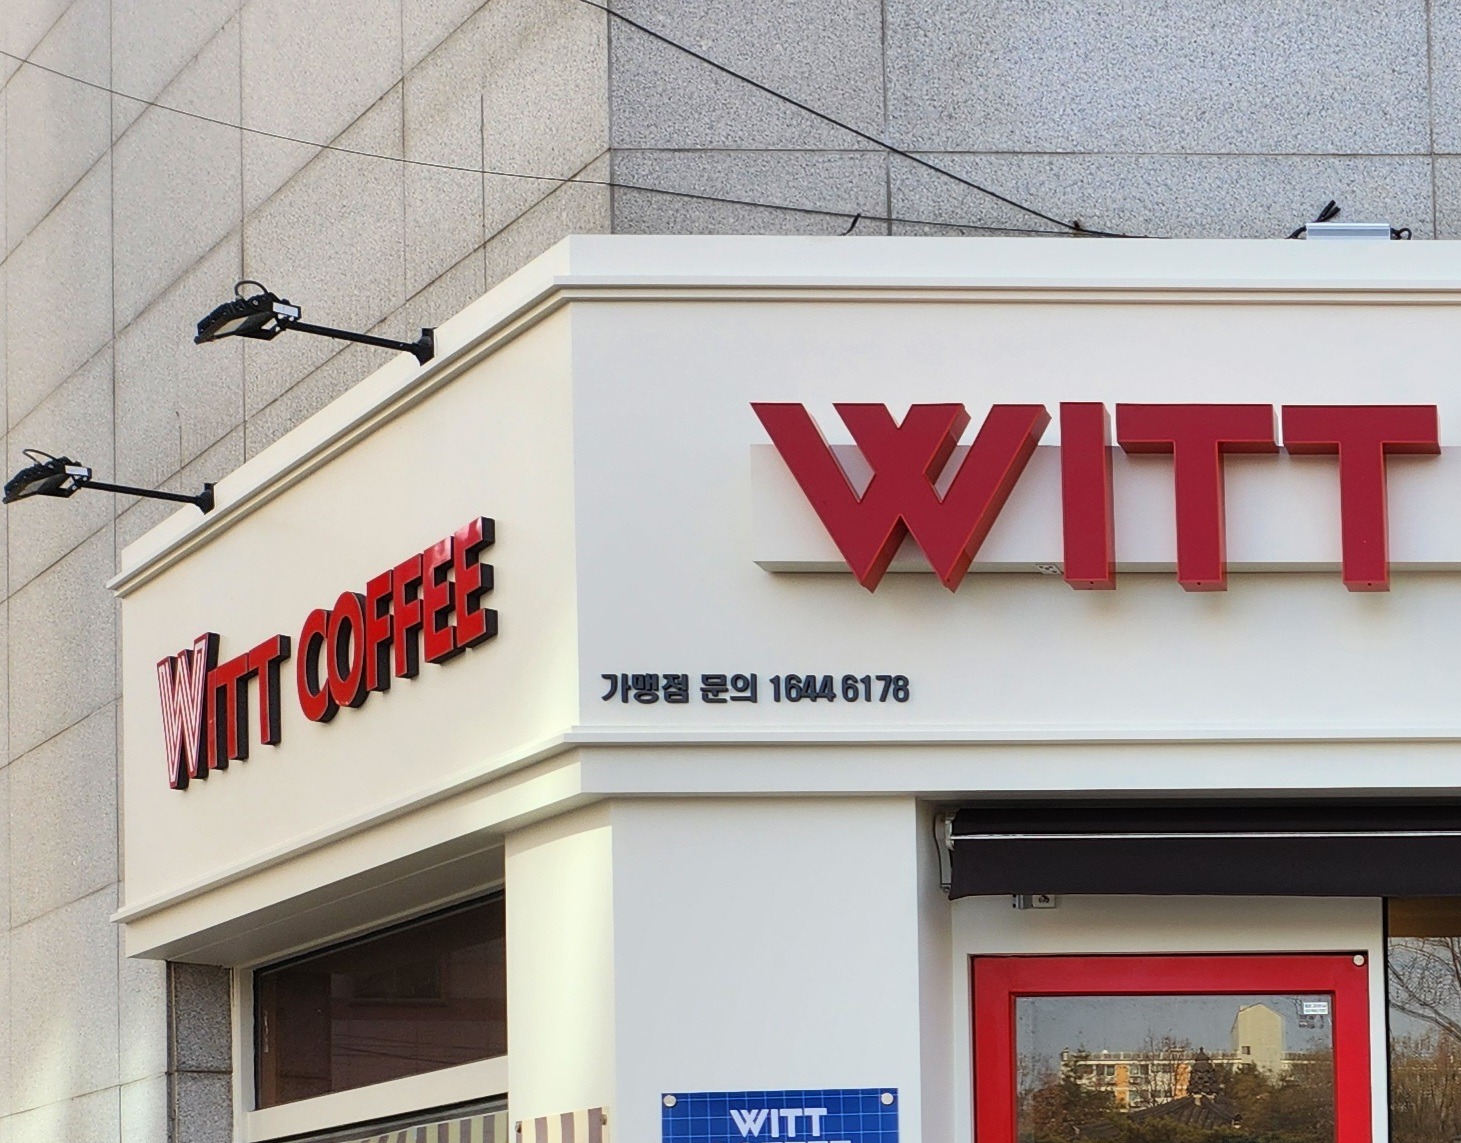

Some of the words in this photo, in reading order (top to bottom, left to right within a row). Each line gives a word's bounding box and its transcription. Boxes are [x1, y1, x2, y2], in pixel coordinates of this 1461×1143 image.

[750, 401, 1441, 594] WITT
[157, 632, 290, 789] WITT
[297, 516, 498, 723] COFFEE
[601, 673, 689, 704] 가맹점
[700, 673, 758, 704] 문의
[769, 674, 836, 704] 1644
[842, 674, 910, 704] 6178
[730, 1107, 828, 1137] WITT
